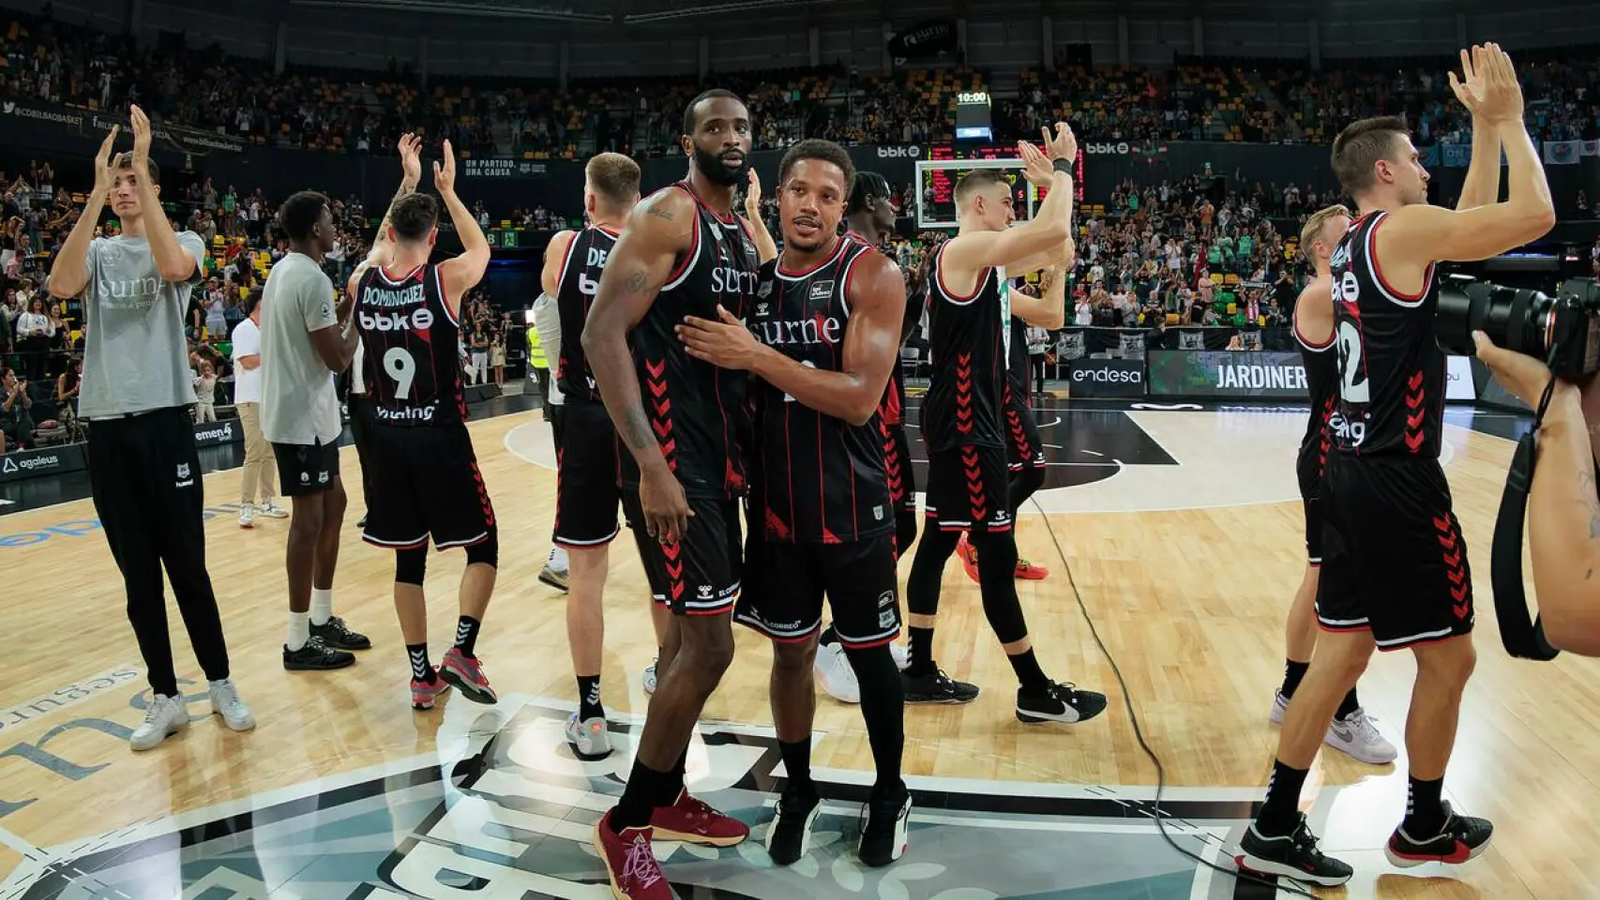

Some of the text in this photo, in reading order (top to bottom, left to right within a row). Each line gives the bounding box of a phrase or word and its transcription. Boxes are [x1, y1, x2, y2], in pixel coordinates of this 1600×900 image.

[957, 92, 986, 102] 10:00
[466, 160, 477, 168] UN
[466, 168, 511, 176] UNA CAUSA
[711, 267, 759, 295] surn
[362, 284, 426, 307] DOMINGUEZ
[360, 311, 410, 331] bbk
[750, 316, 840, 345] surne
[383, 347, 416, 400] 9
[1072, 366, 1141, 383] endesa
[1216, 365, 1309, 389] JARDINER
